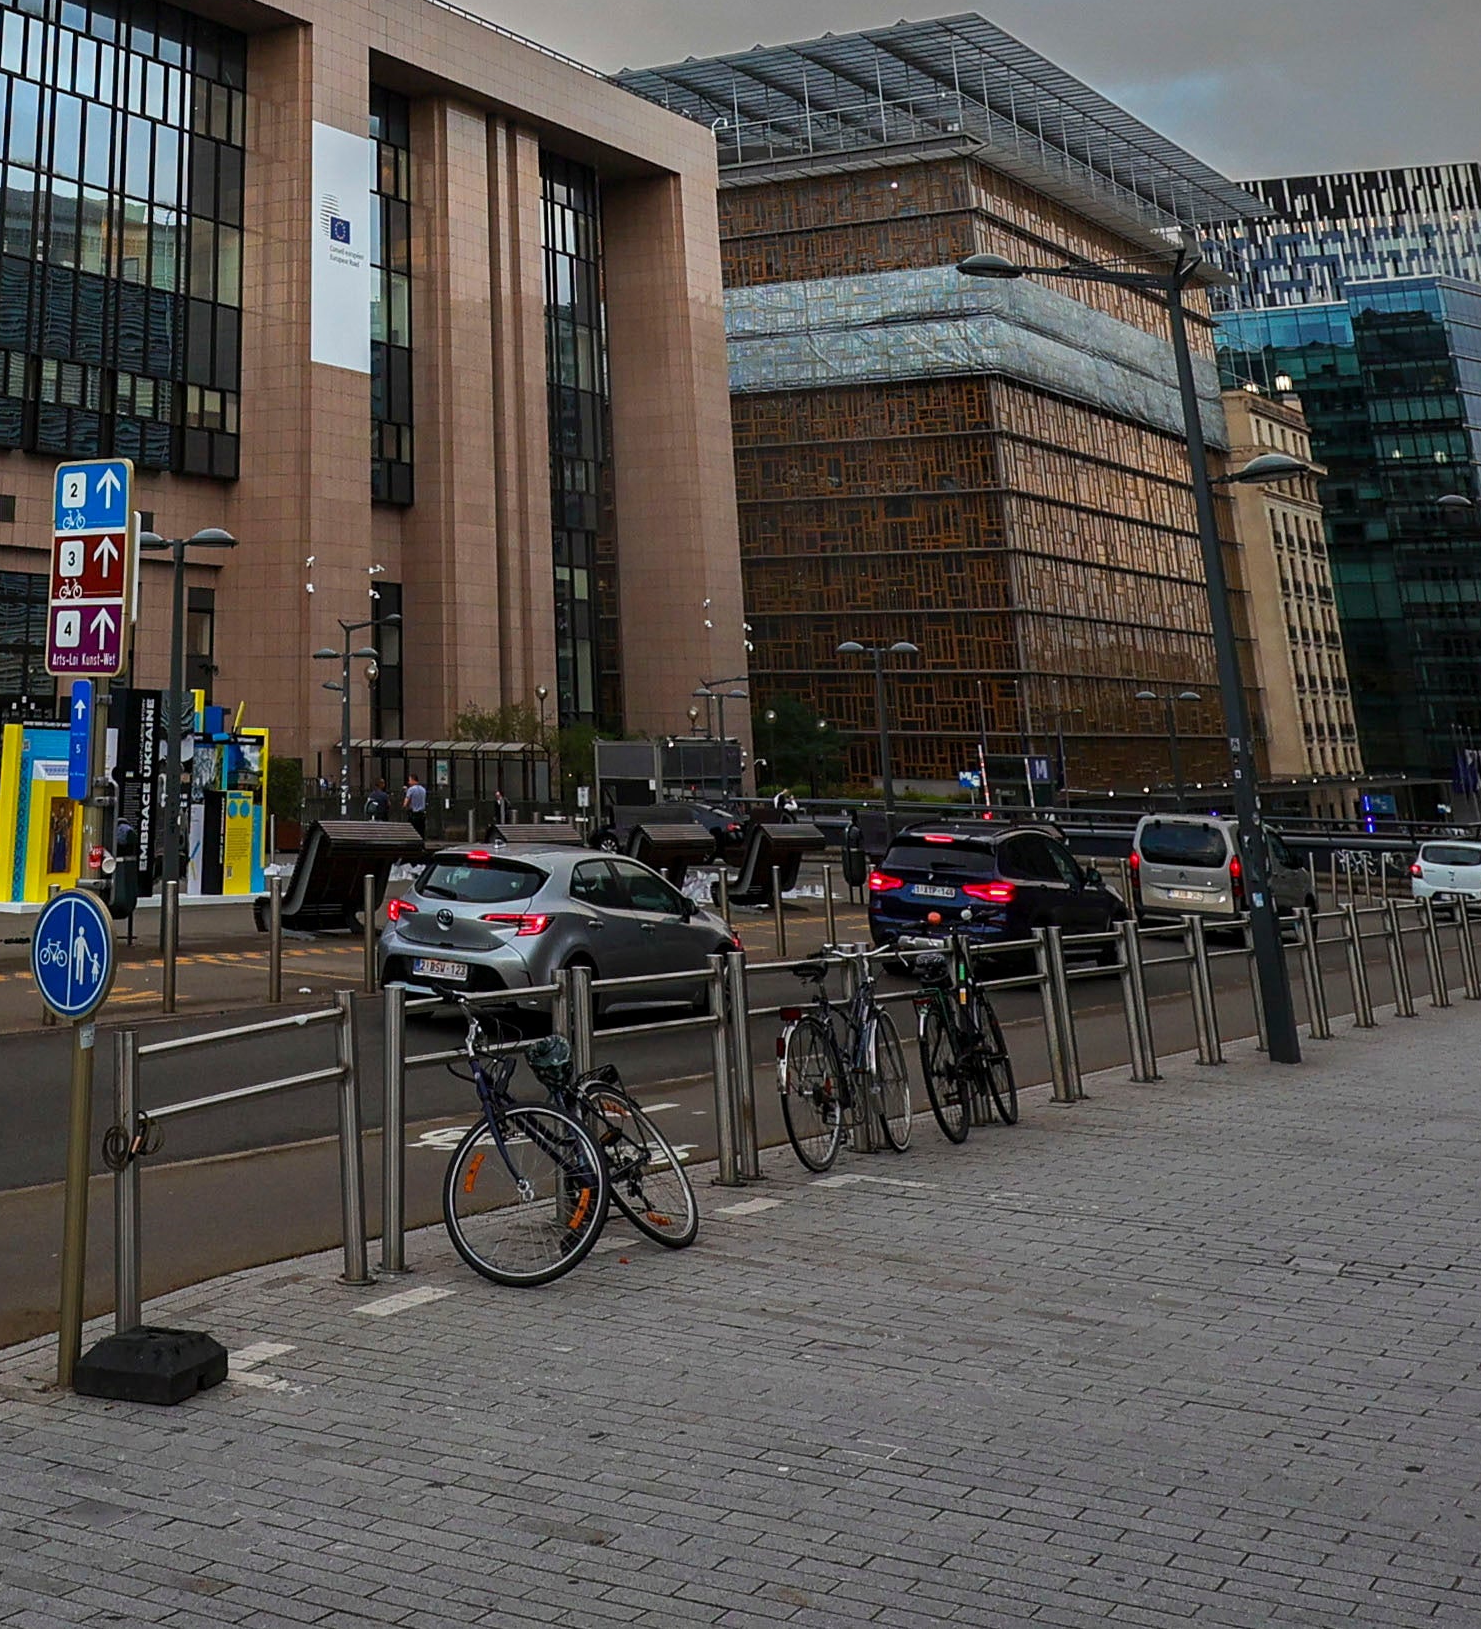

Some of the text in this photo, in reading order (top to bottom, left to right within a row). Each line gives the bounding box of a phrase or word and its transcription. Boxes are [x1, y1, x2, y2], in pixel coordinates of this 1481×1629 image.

[70, 483, 78, 498] 2
[68, 551, 76, 567] 3
[64, 621, 72, 637] 4
[52, 652, 117, 668] Arts-Loi Kunst-Wet
[138, 698, 155, 871] EMBRACE UKRAINE
